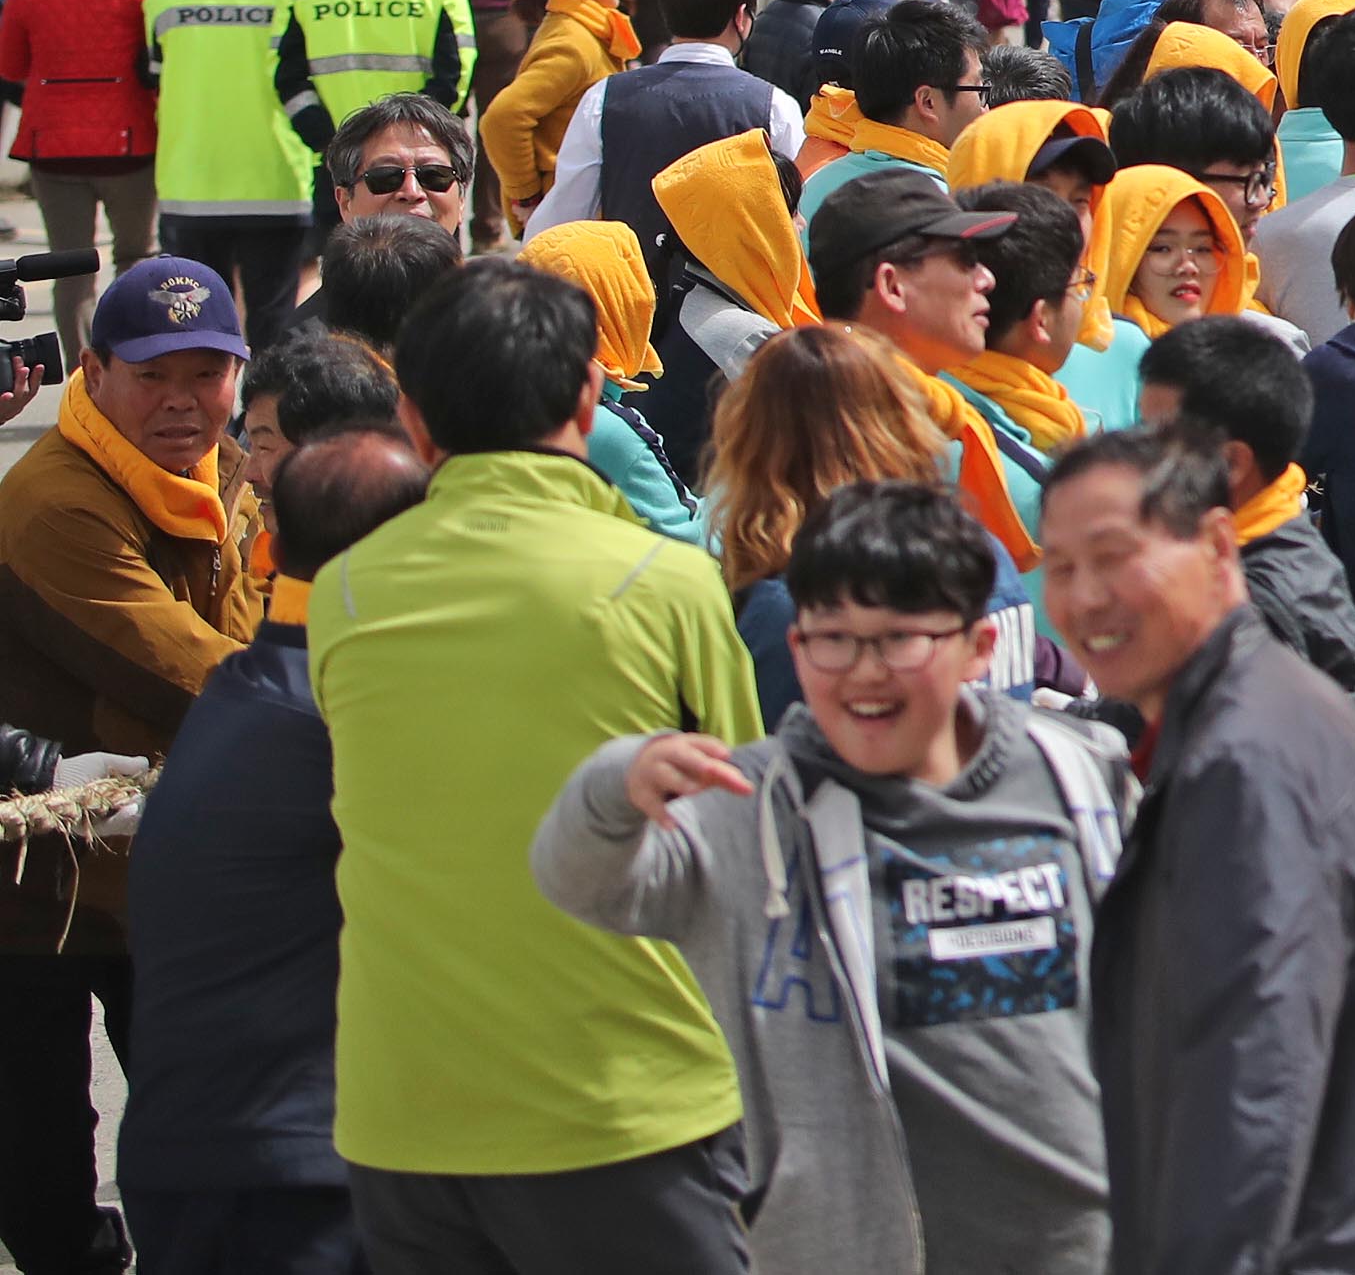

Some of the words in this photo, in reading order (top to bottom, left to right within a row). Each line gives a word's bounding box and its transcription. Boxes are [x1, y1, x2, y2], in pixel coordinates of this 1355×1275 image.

[314, 1, 425, 20] POLICE
[160, 276, 200, 291] ROKMC
[903, 861, 1066, 924] RESPECT
